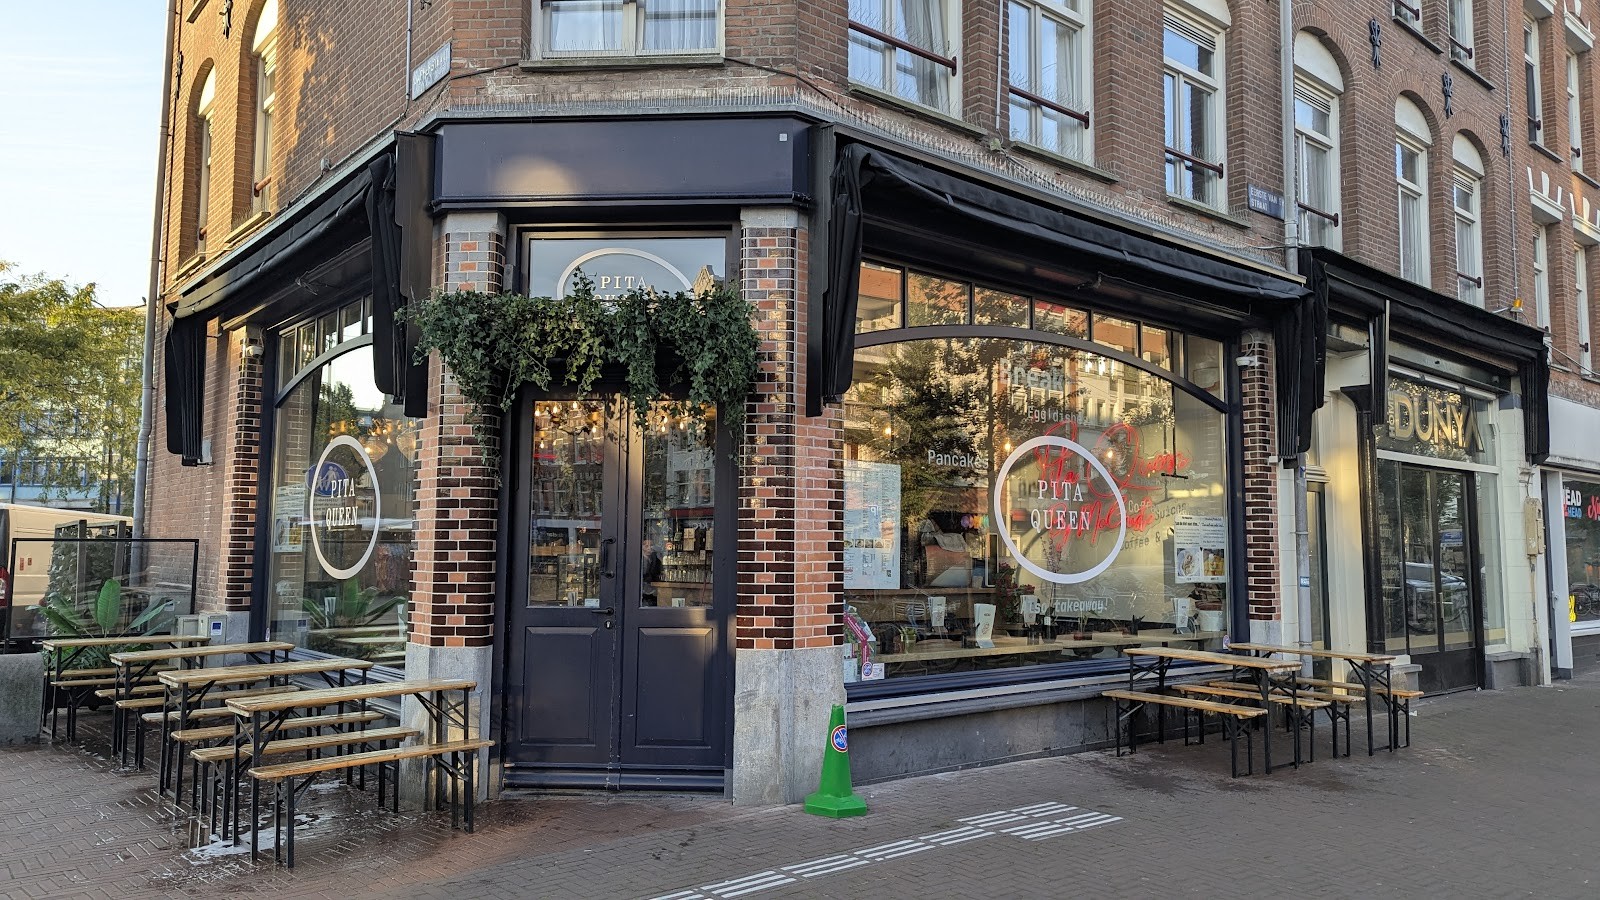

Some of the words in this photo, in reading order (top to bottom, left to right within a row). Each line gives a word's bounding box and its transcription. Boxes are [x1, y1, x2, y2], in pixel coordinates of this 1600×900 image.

[601, 275, 647, 289] PITA
[999, 358, 1066, 391] Break
[927, 449, 989, 469] Pancakes
[330, 477, 356, 499] PITA
[1037, 480, 1084, 502] PITA
[326, 506, 359, 531] QUEEN
[1030, 508, 1091, 533] QUEEN
[1054, 597, 1107, 614] takeaway!
